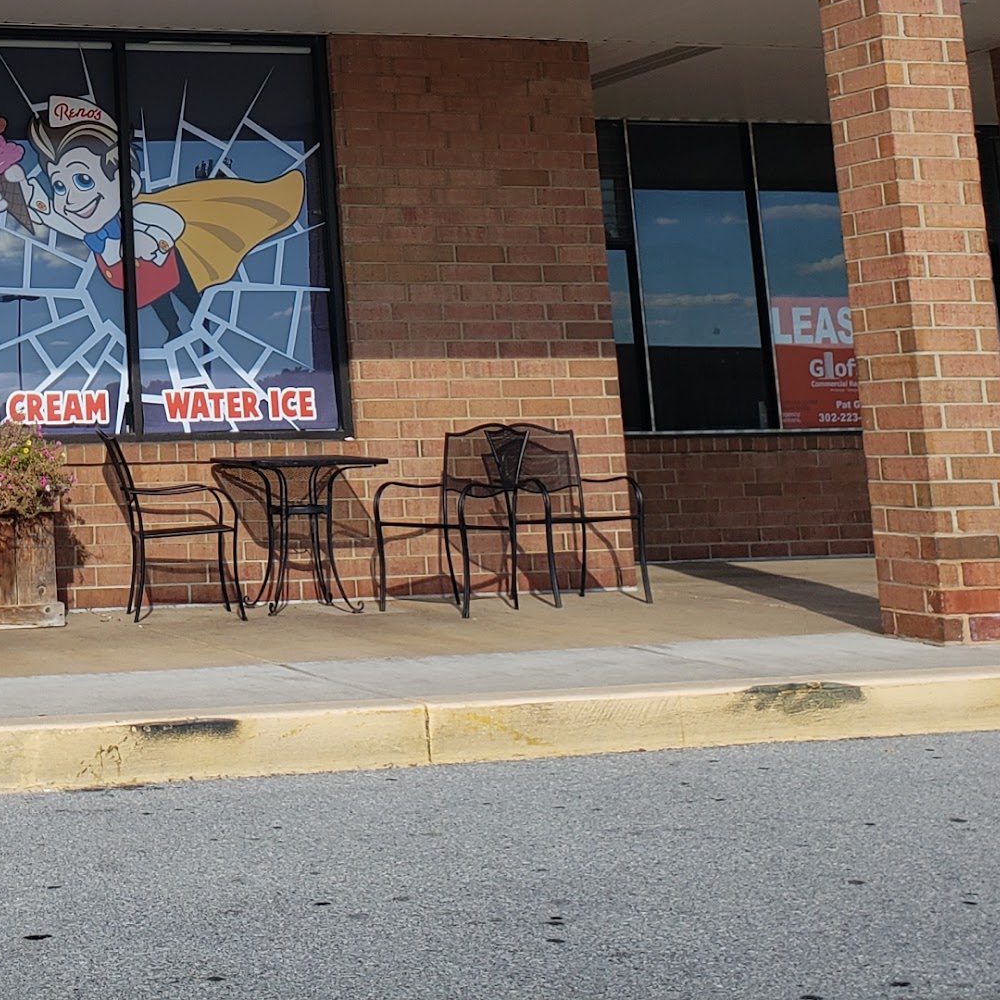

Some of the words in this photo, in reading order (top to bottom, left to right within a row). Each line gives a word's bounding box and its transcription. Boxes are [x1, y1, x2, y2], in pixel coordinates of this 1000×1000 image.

[54, 103, 102, 121] Reno's
[772, 307, 853, 344] LEAS
[6, 391, 109, 424] CREAM
[163, 390, 261, 421] WATER
[269, 388, 316, 419] ICE
[836, 400, 851, 409] Pat
